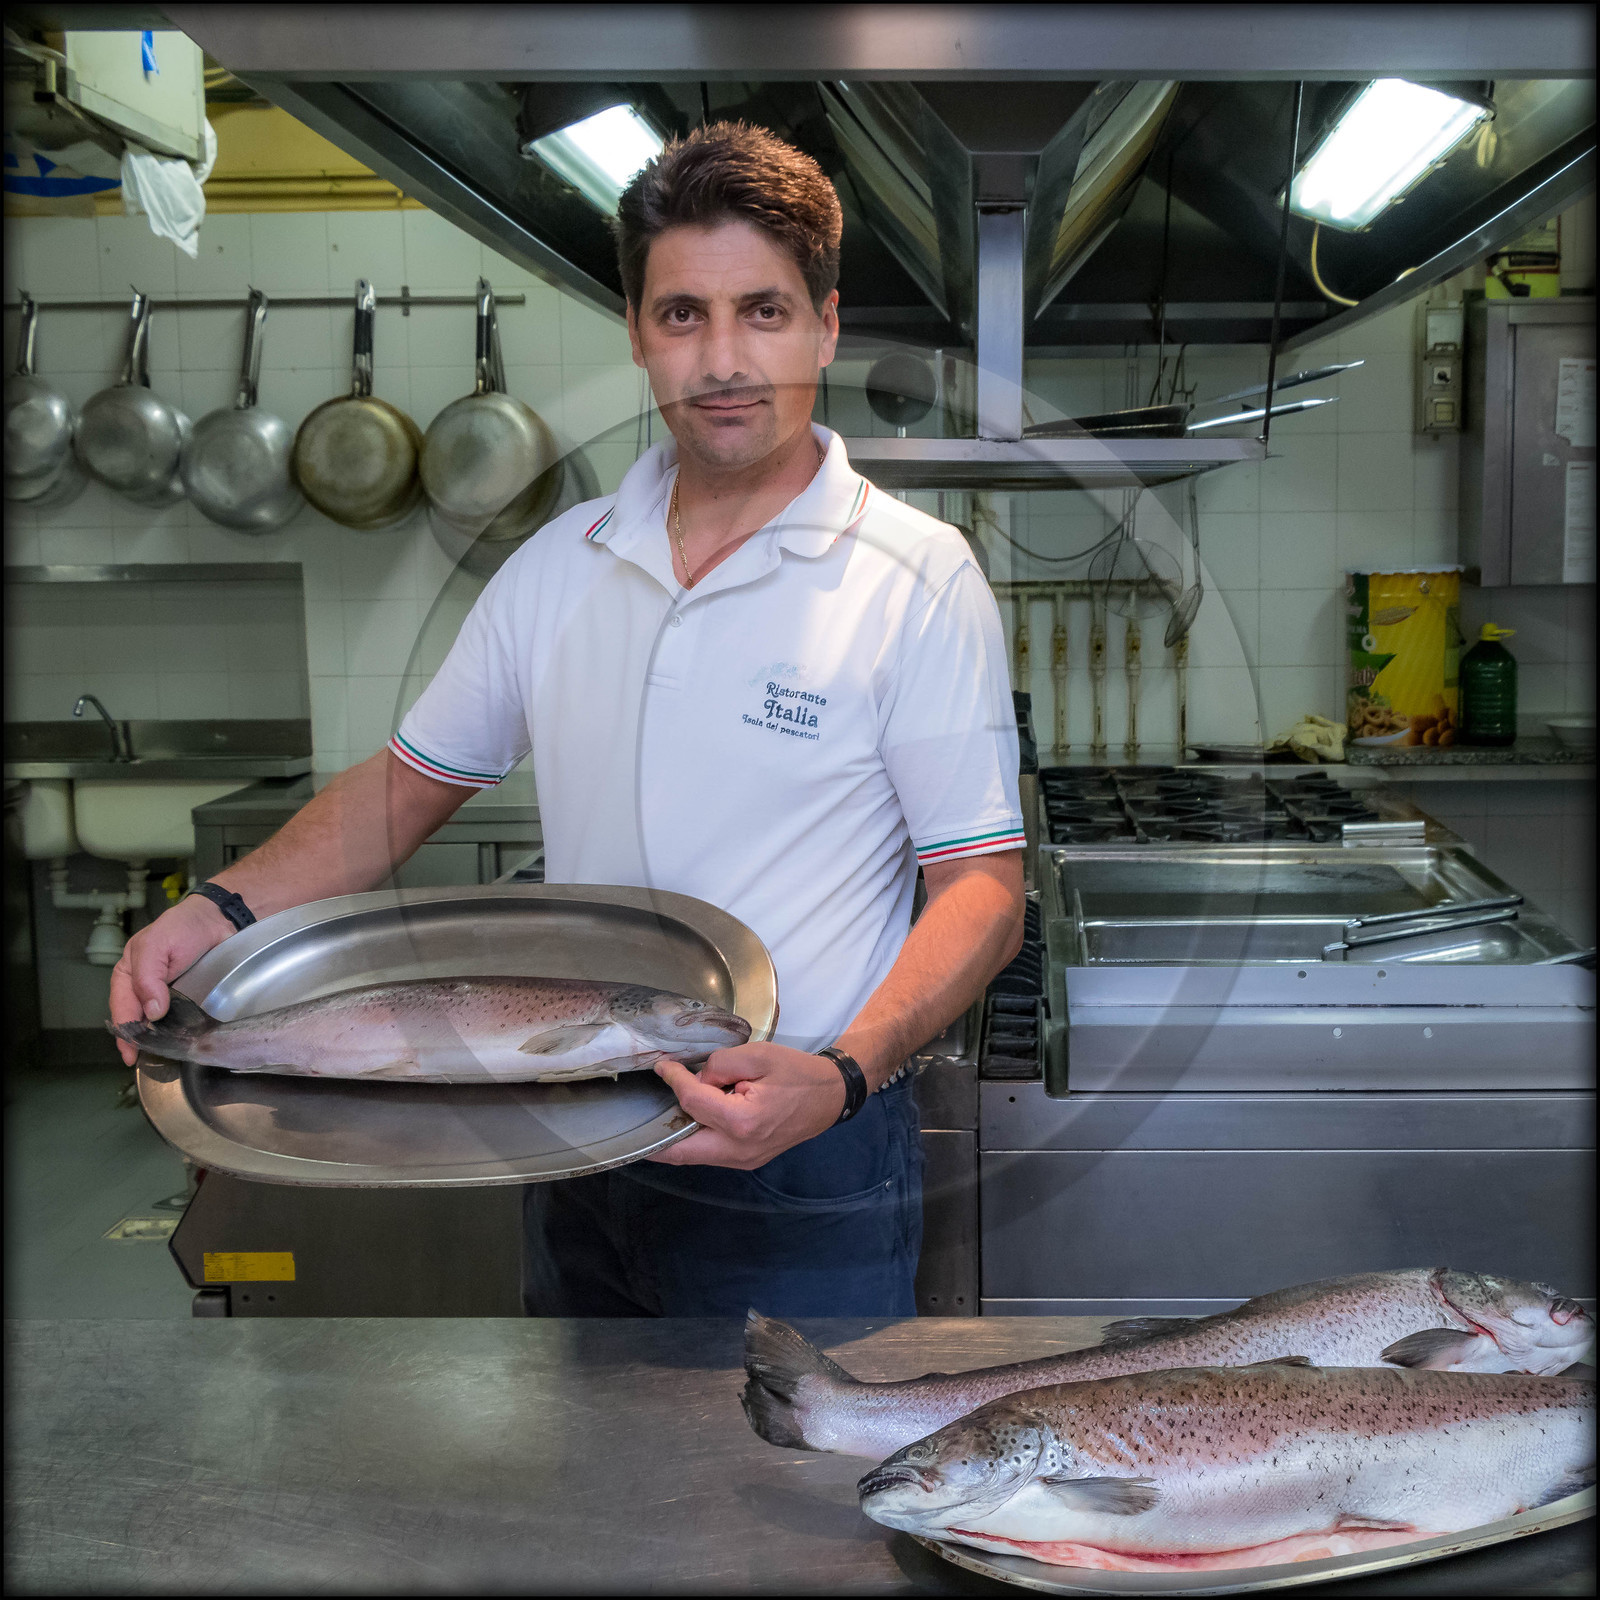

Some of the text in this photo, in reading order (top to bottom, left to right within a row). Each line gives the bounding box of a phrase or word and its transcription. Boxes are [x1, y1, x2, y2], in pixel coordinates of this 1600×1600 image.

[766, 682, 827, 706] Ristorante
[764, 699, 818, 728] Italia
[742, 714, 763, 727] Isola
[780, 727, 820, 741] pescatori
